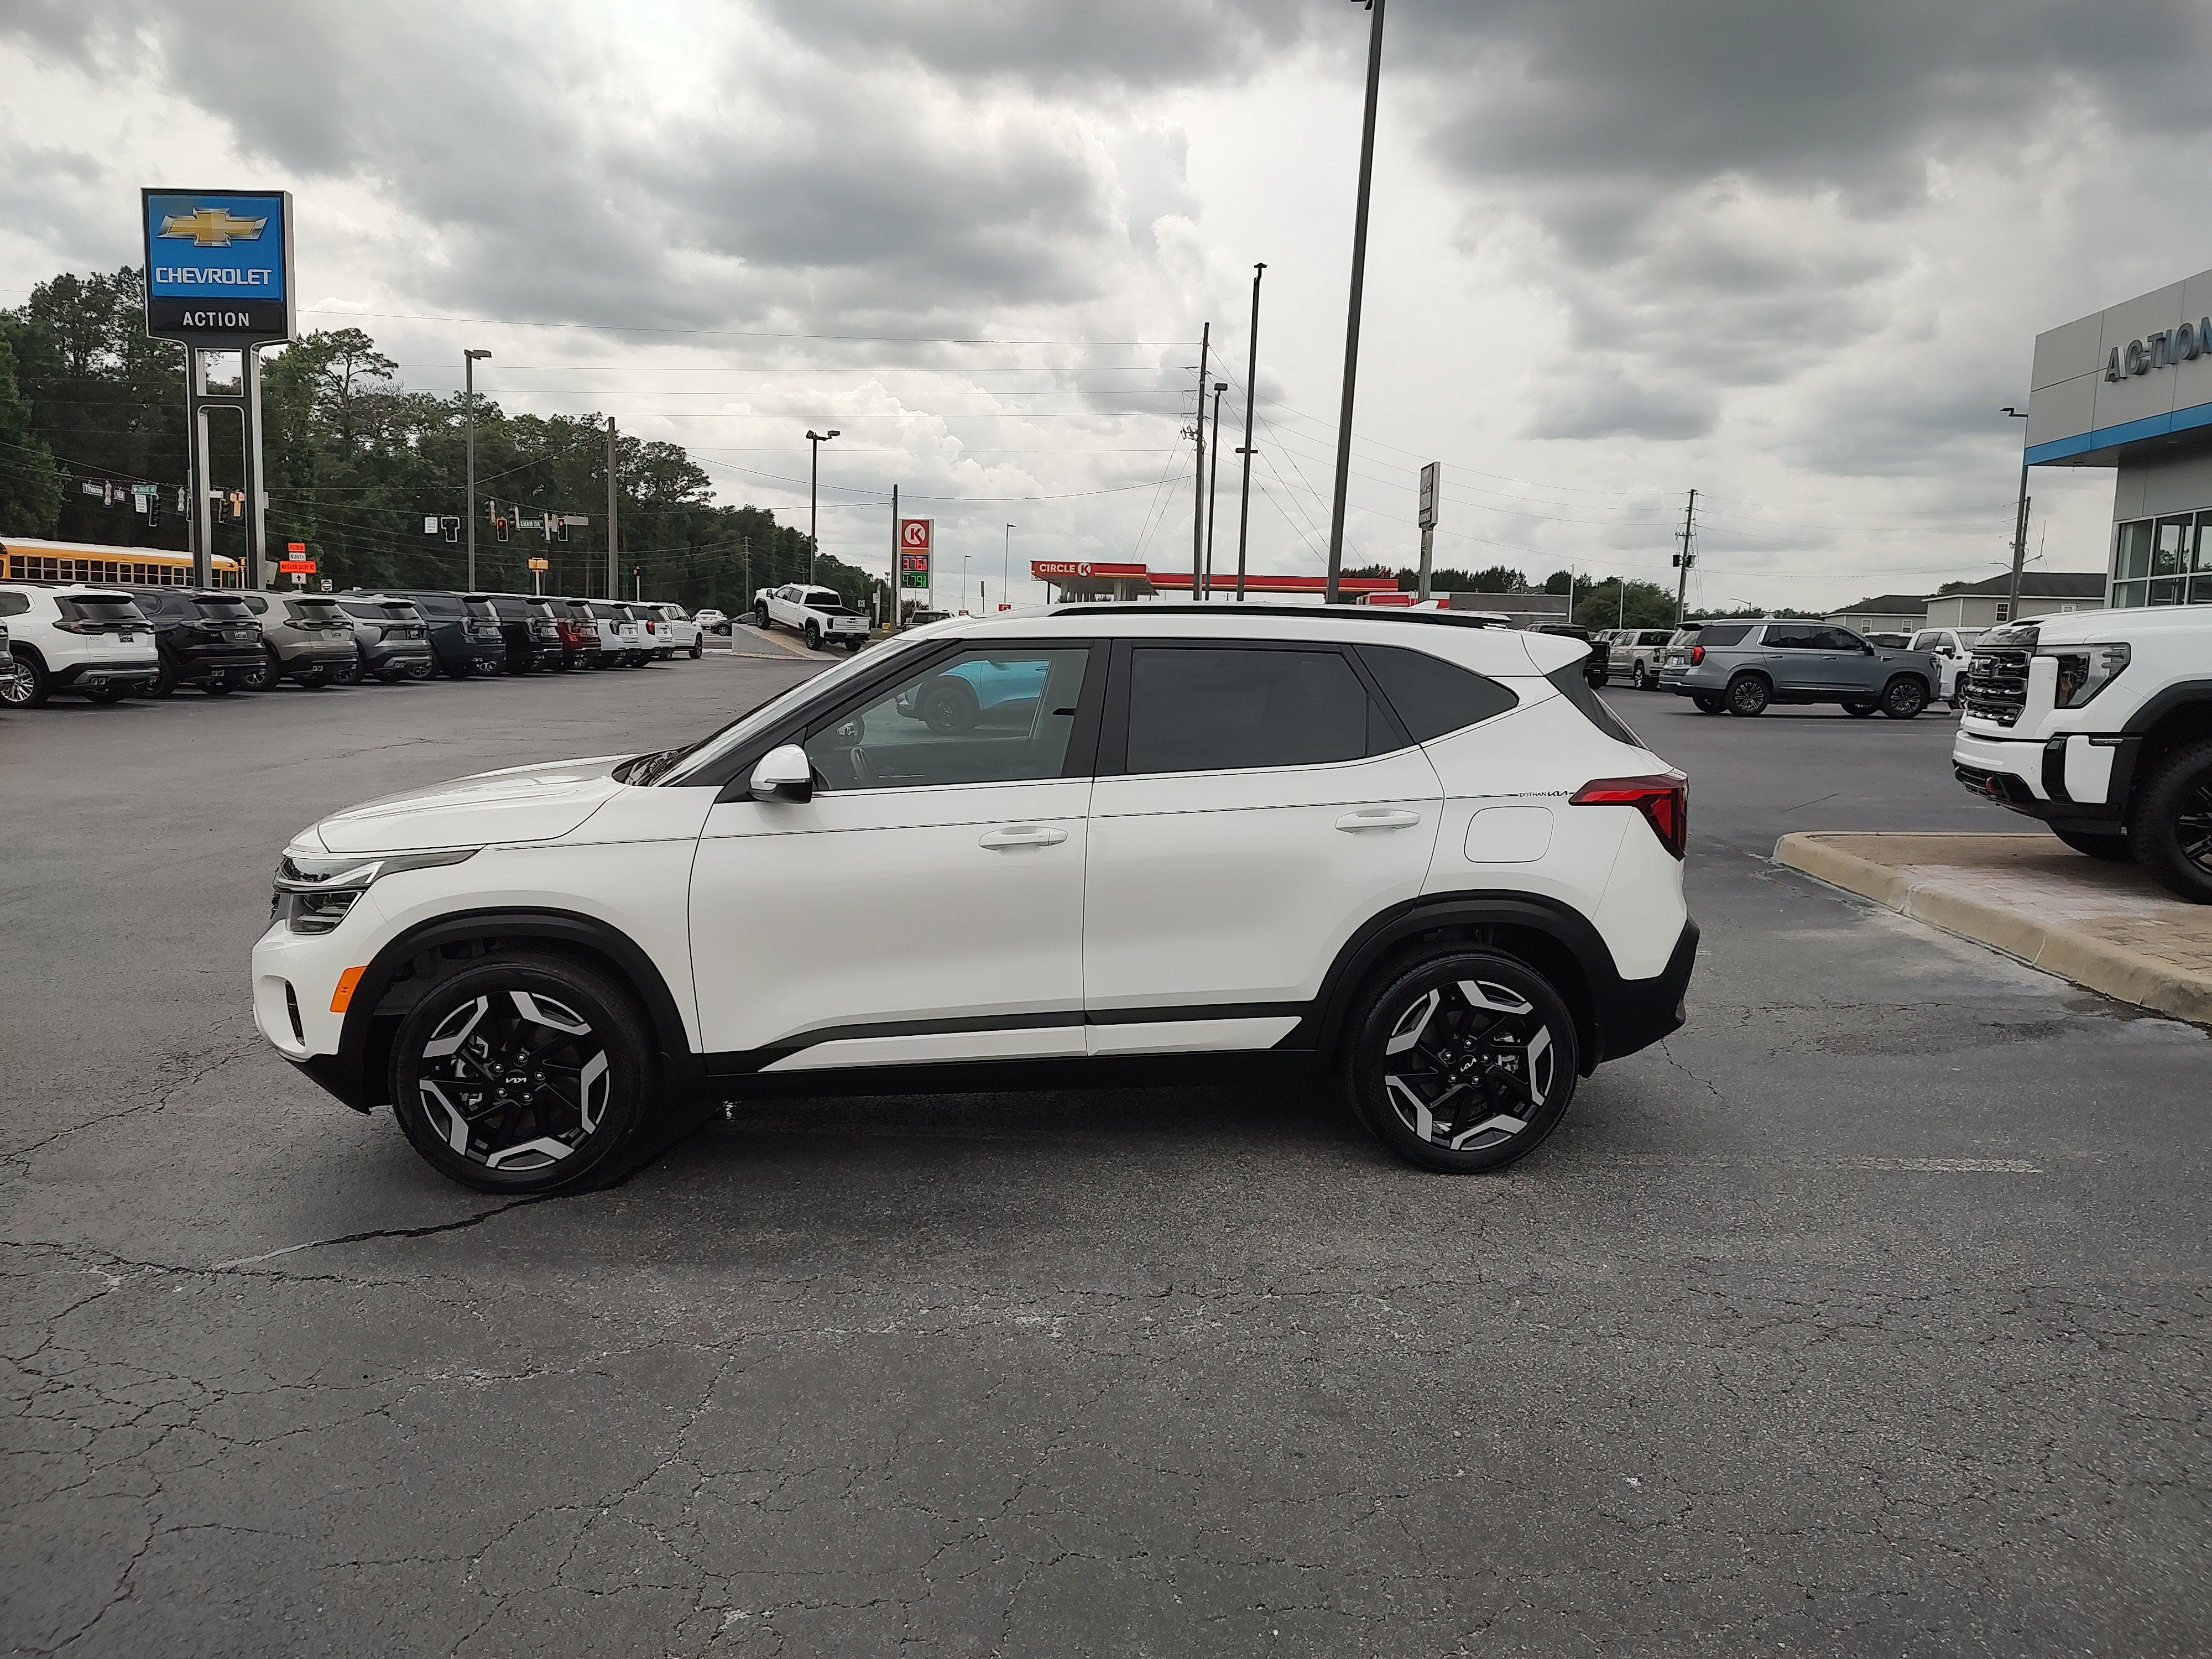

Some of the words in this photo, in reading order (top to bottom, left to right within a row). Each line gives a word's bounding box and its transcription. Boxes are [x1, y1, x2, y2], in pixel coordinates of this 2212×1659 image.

[155, 267, 272, 285] CHEVROLET
[182, 311, 249, 326] ACTION
[2104, 317, 2212, 382] ACTION
[84, 484, 103, 494] Thoma
[910, 528, 924, 542] K
[1040, 564, 1076, 573] CIRCLE
